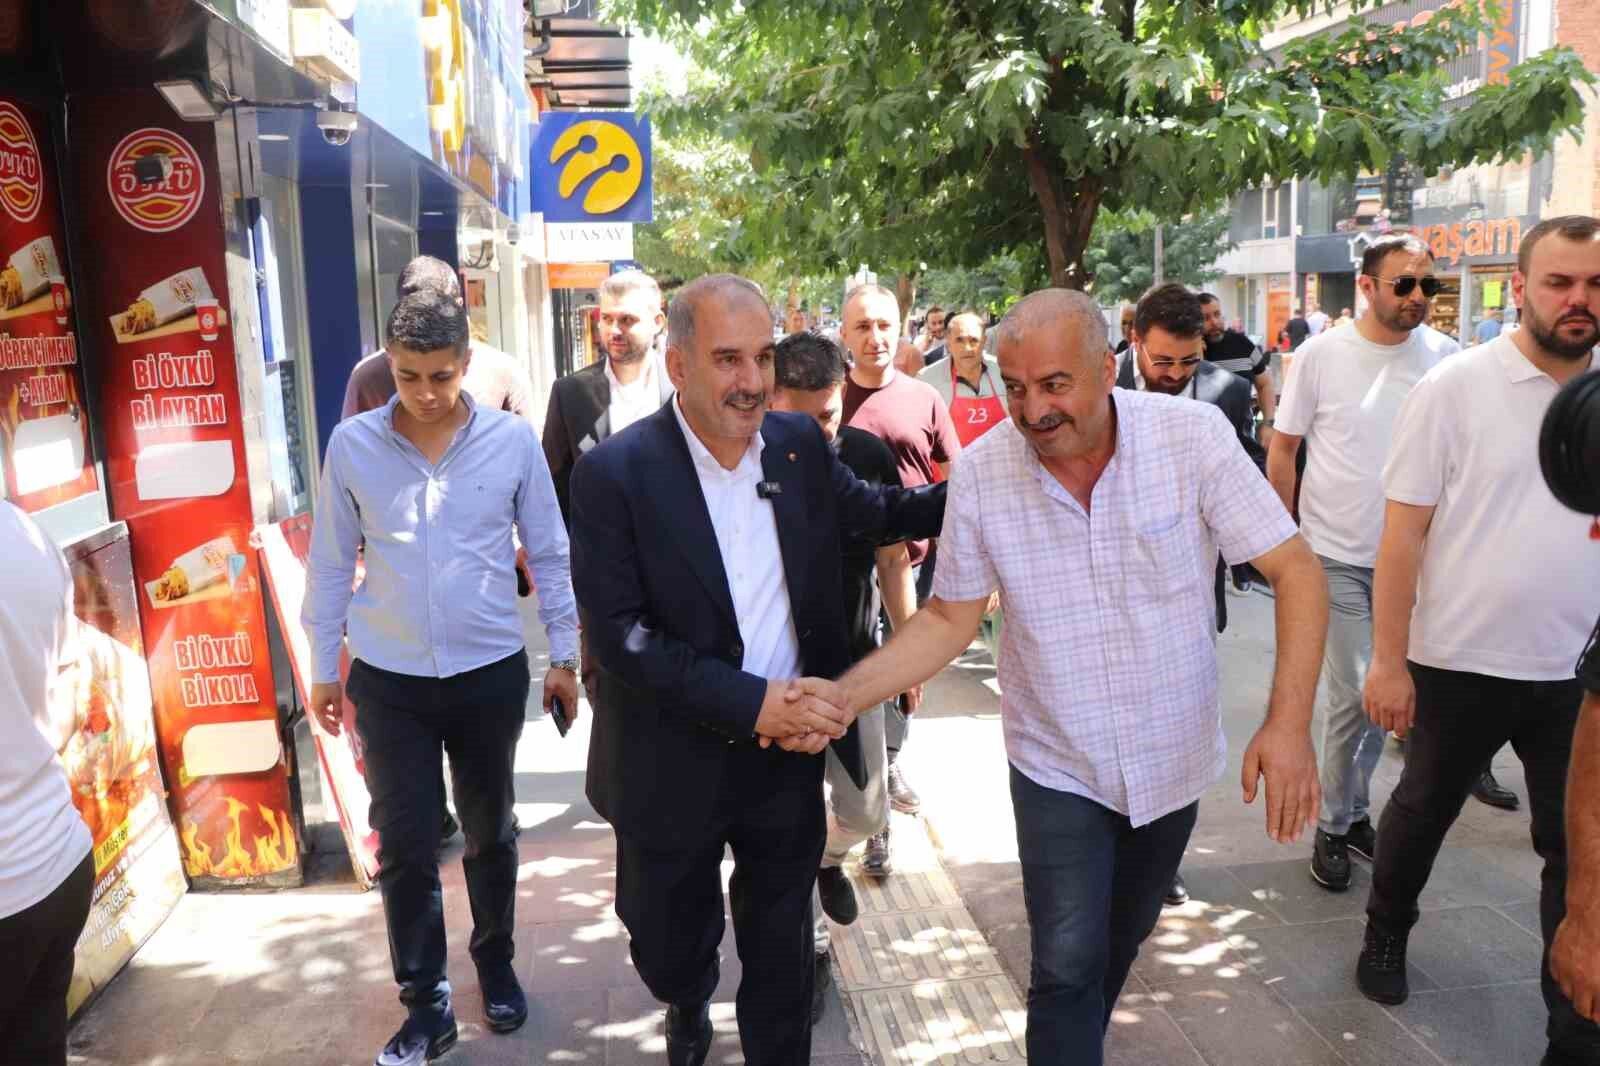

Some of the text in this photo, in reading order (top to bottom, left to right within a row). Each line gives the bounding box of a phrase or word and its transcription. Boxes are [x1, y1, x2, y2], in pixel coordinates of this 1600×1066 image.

[133, 350, 215, 391] Bİ ÖYKÜ
[30, 374, 67, 406] AYRAN
[130, 394, 227, 430] Bİ AYRAN
[966, 407, 988, 424] 23
[175, 633, 254, 672] Bİ ÖYKÜ
[181, 673, 260, 708] Bİ KOLA
